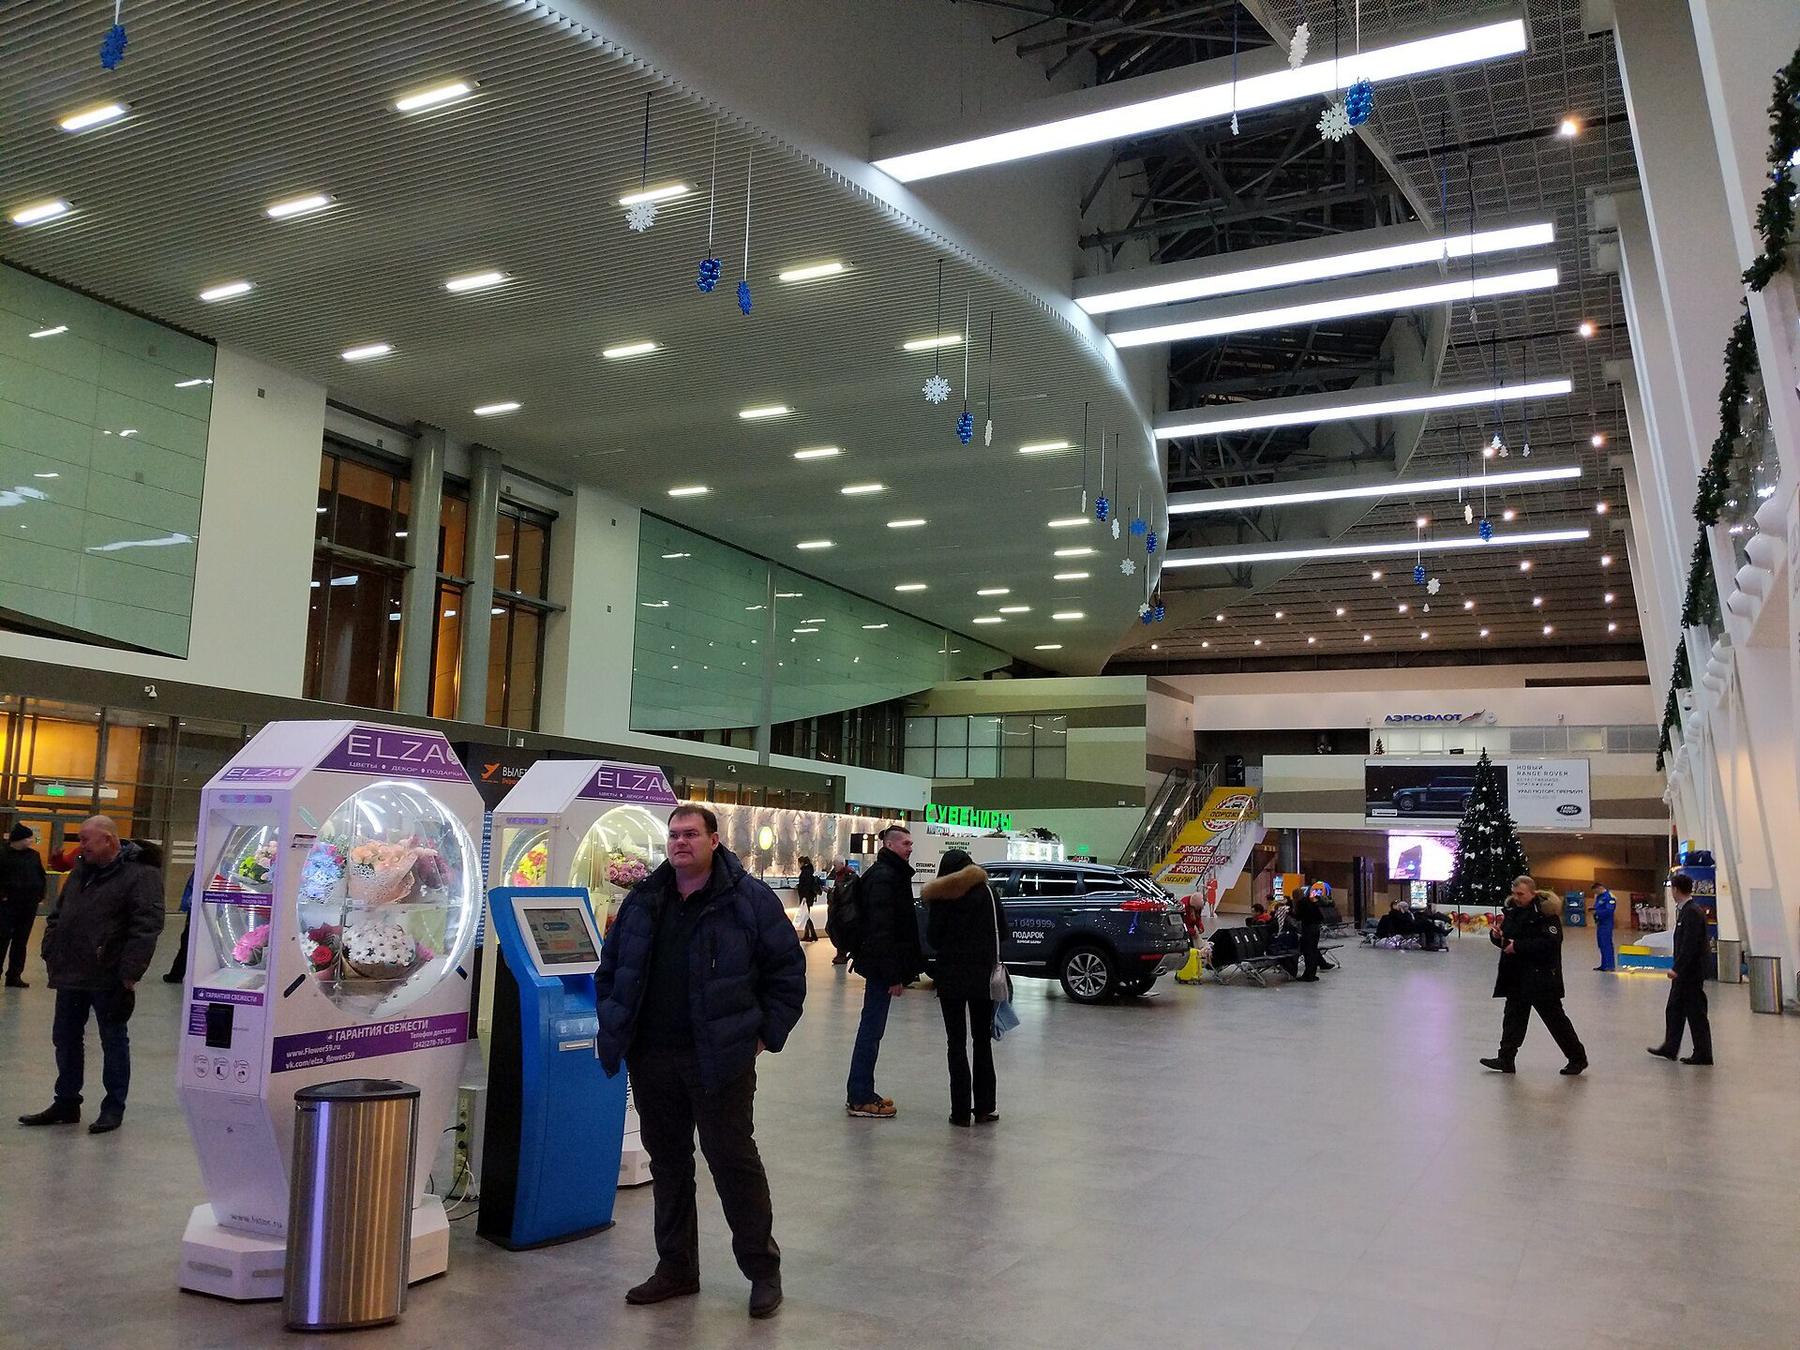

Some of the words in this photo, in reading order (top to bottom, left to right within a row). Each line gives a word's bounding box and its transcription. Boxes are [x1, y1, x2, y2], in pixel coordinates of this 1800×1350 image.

[1384, 713, 1462, 722] АЭРОФЛОТ
[347, 734, 445, 764] ELZA
[1236, 758, 1243, 768] 2
[226, 768, 282, 777] ELZA
[349, 761, 378, 769] ЦВЕТЫ
[426, 768, 463, 777] ПОДАРКИ
[597, 771, 663, 793] ELZA
[925, 803, 1012, 831] СУВЕНИРЫ
[1182, 845, 1213, 853] ДОБРОЕ
[1012, 931, 1045, 939] ПОДАРОК
[335, 1026, 382, 1042] ГАРАНТИЯ
[383, 1020, 429, 1036] СВЕЖЕСТИ
[410, 1031, 433, 1039] Телефон
